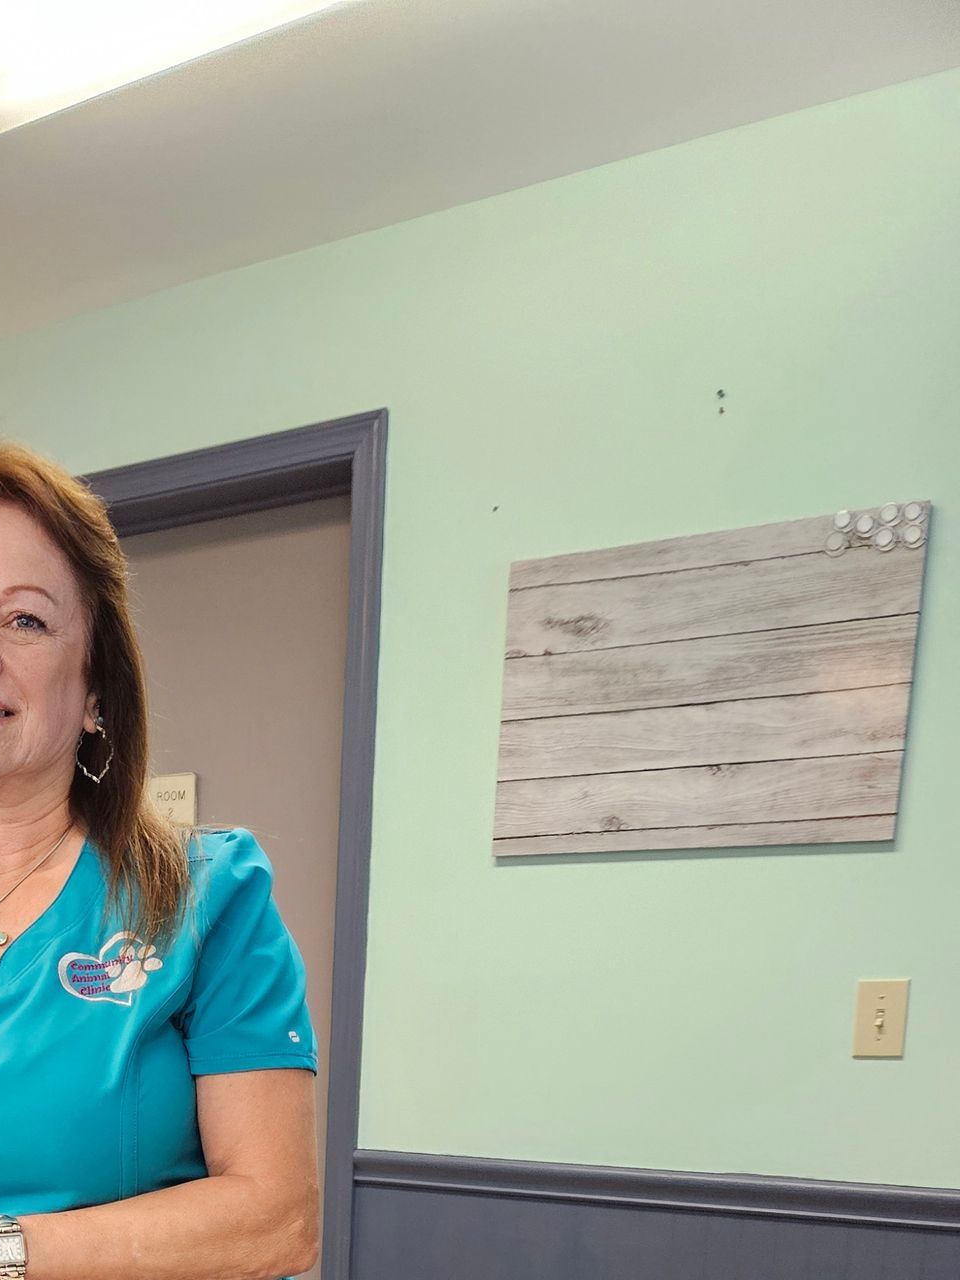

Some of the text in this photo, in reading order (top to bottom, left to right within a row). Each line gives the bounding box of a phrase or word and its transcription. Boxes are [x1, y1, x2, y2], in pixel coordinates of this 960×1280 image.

[156, 790, 186, 802] ROOM
[70, 953, 134, 971] Community
[71, 972, 111, 983] Animal
[79, 983, 111, 996] Clinic
